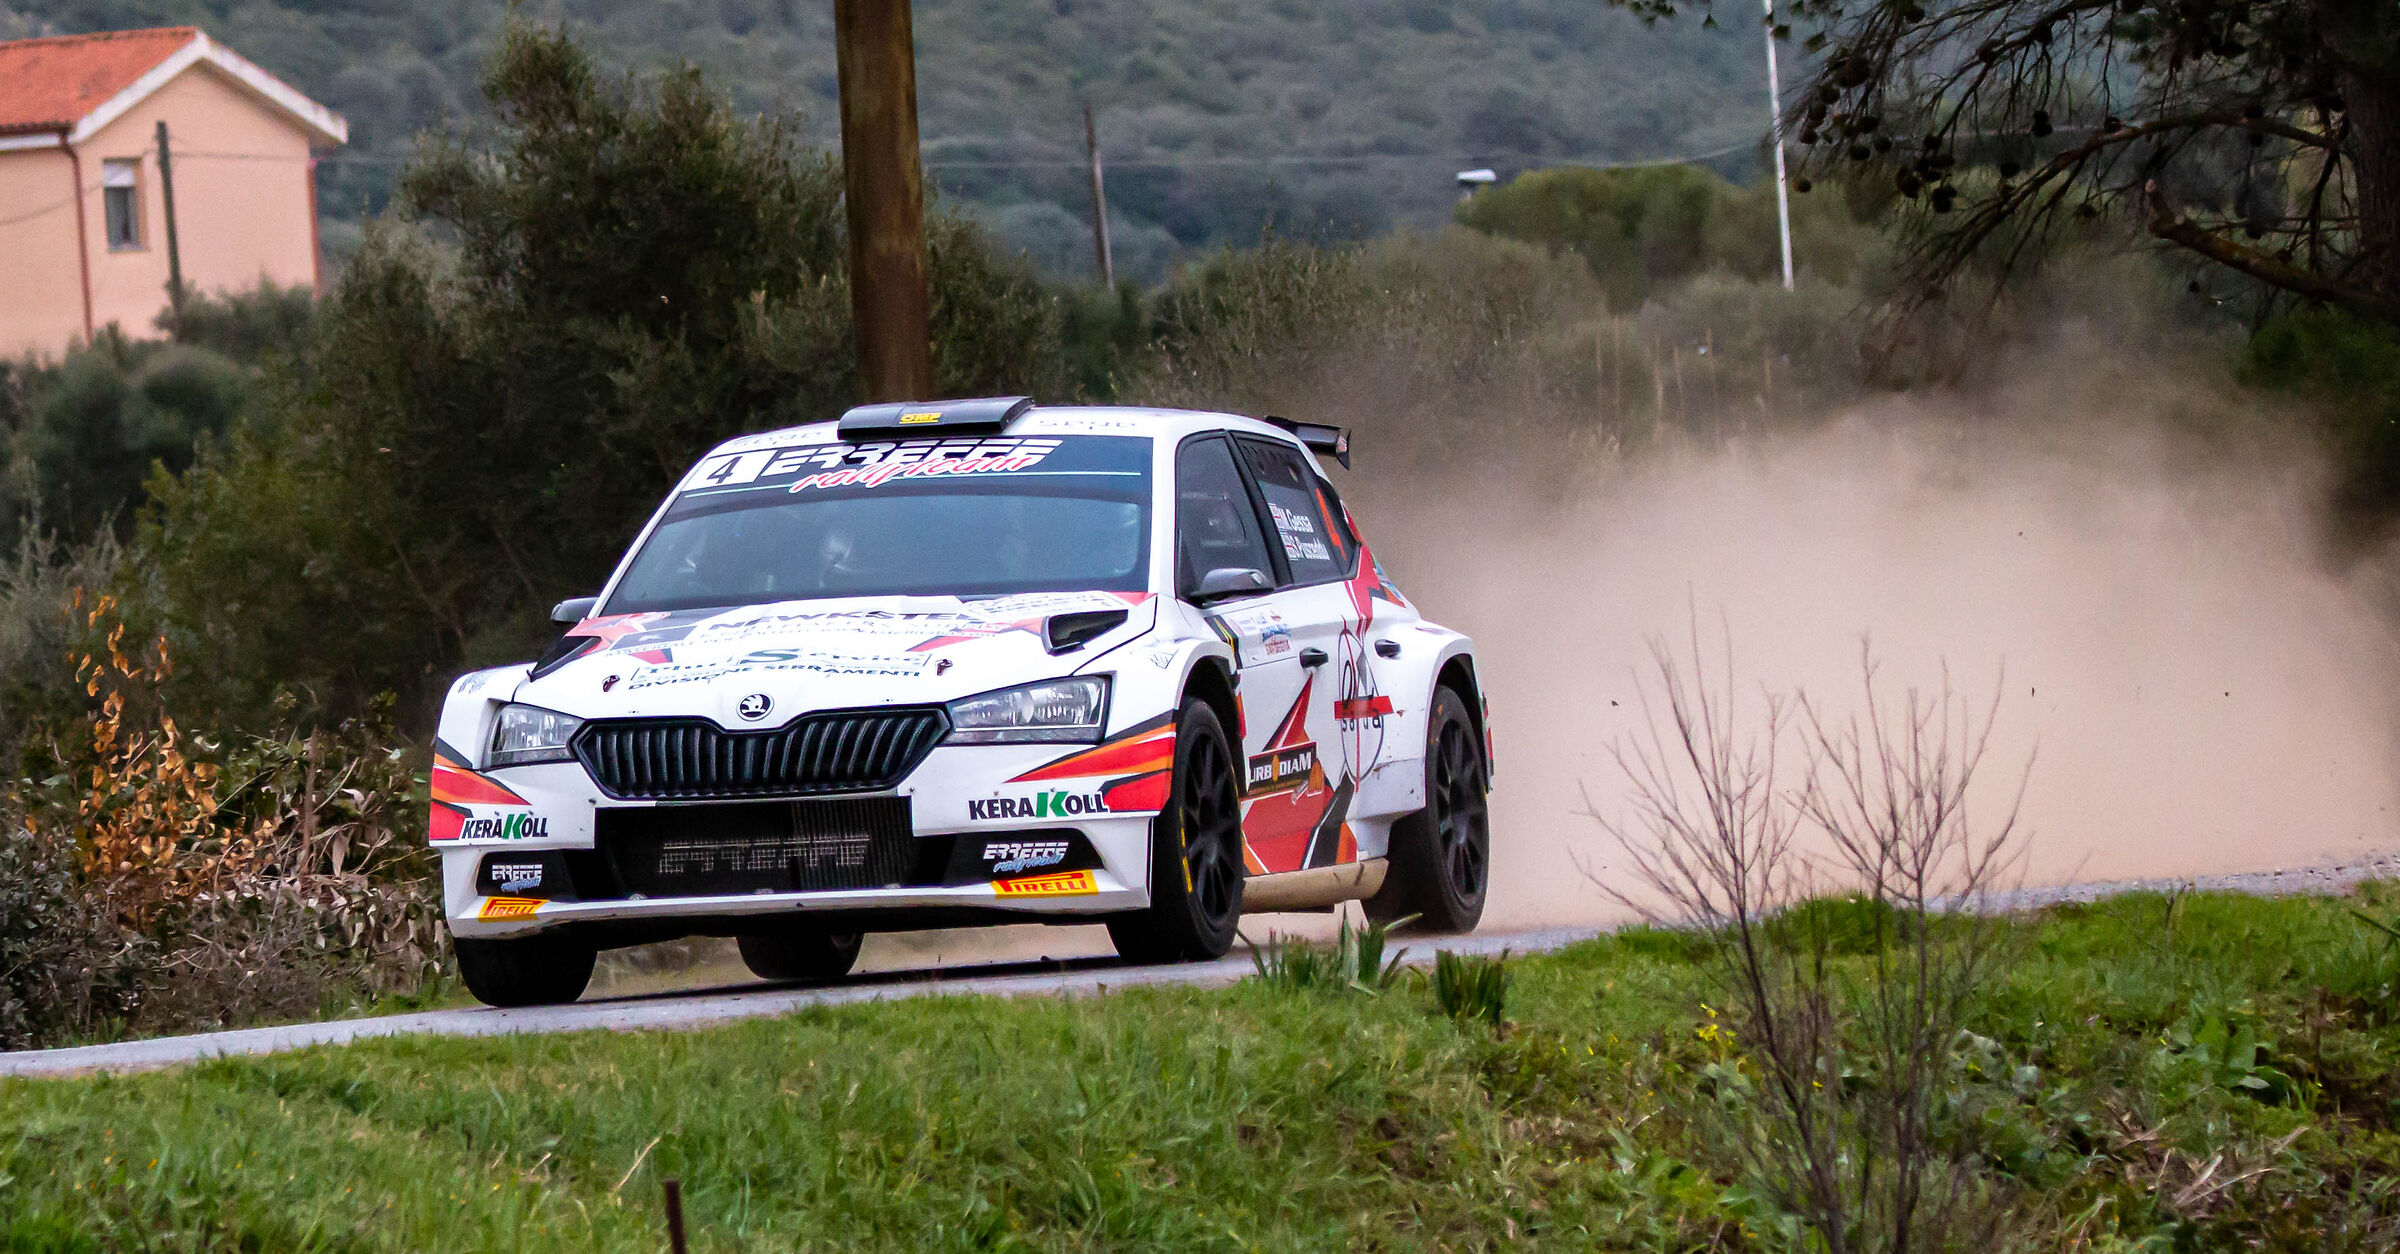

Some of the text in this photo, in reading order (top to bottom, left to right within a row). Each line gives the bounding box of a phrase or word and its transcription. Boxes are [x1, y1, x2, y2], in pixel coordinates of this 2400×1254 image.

[900, 412, 942, 424] OMP
[706, 455, 743, 485] 4
[1286, 508, 1314, 533] Gessa
[628, 667, 752, 690] DIVISIONE
[764, 664, 921, 677] SERRAMENTI
[968, 790, 1109, 821] KERAKOLL
[461, 813, 549, 840] KERAKOLL
[998, 872, 1088, 893] PIRELLI
[486, 899, 543, 917] PIRELLI
